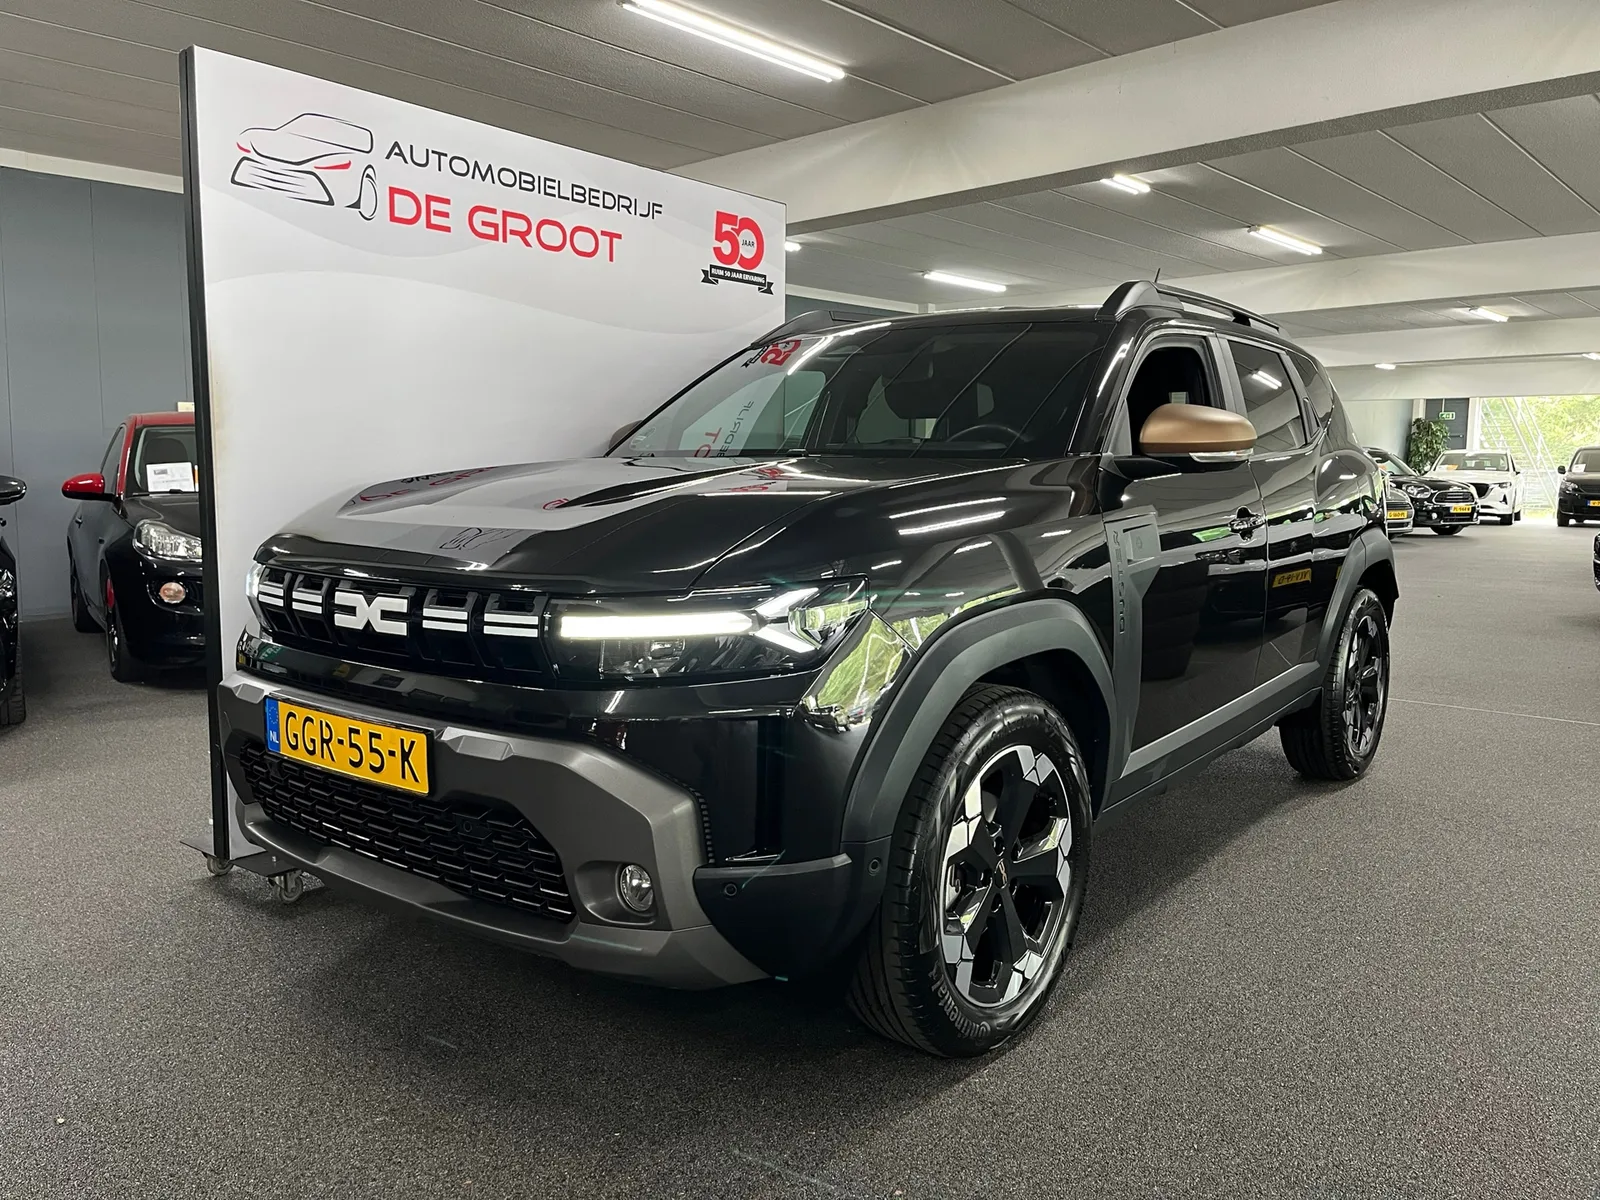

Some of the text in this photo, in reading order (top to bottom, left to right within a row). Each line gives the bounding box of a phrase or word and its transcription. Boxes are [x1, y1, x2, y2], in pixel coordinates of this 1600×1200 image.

[385, 141, 663, 220] AUTOMOBIELBEDRIJF
[388, 186, 622, 262] DE GROOT
[713, 211, 765, 270] 50
[741, 239, 755, 248] JAAR
[711, 268, 724, 276] RUIM
[731, 272, 742, 280] JAAR
[743, 274, 765, 283] ERVARING
[269, 730, 280, 744] NL
[284, 711, 421, 783] GGR-55-K
